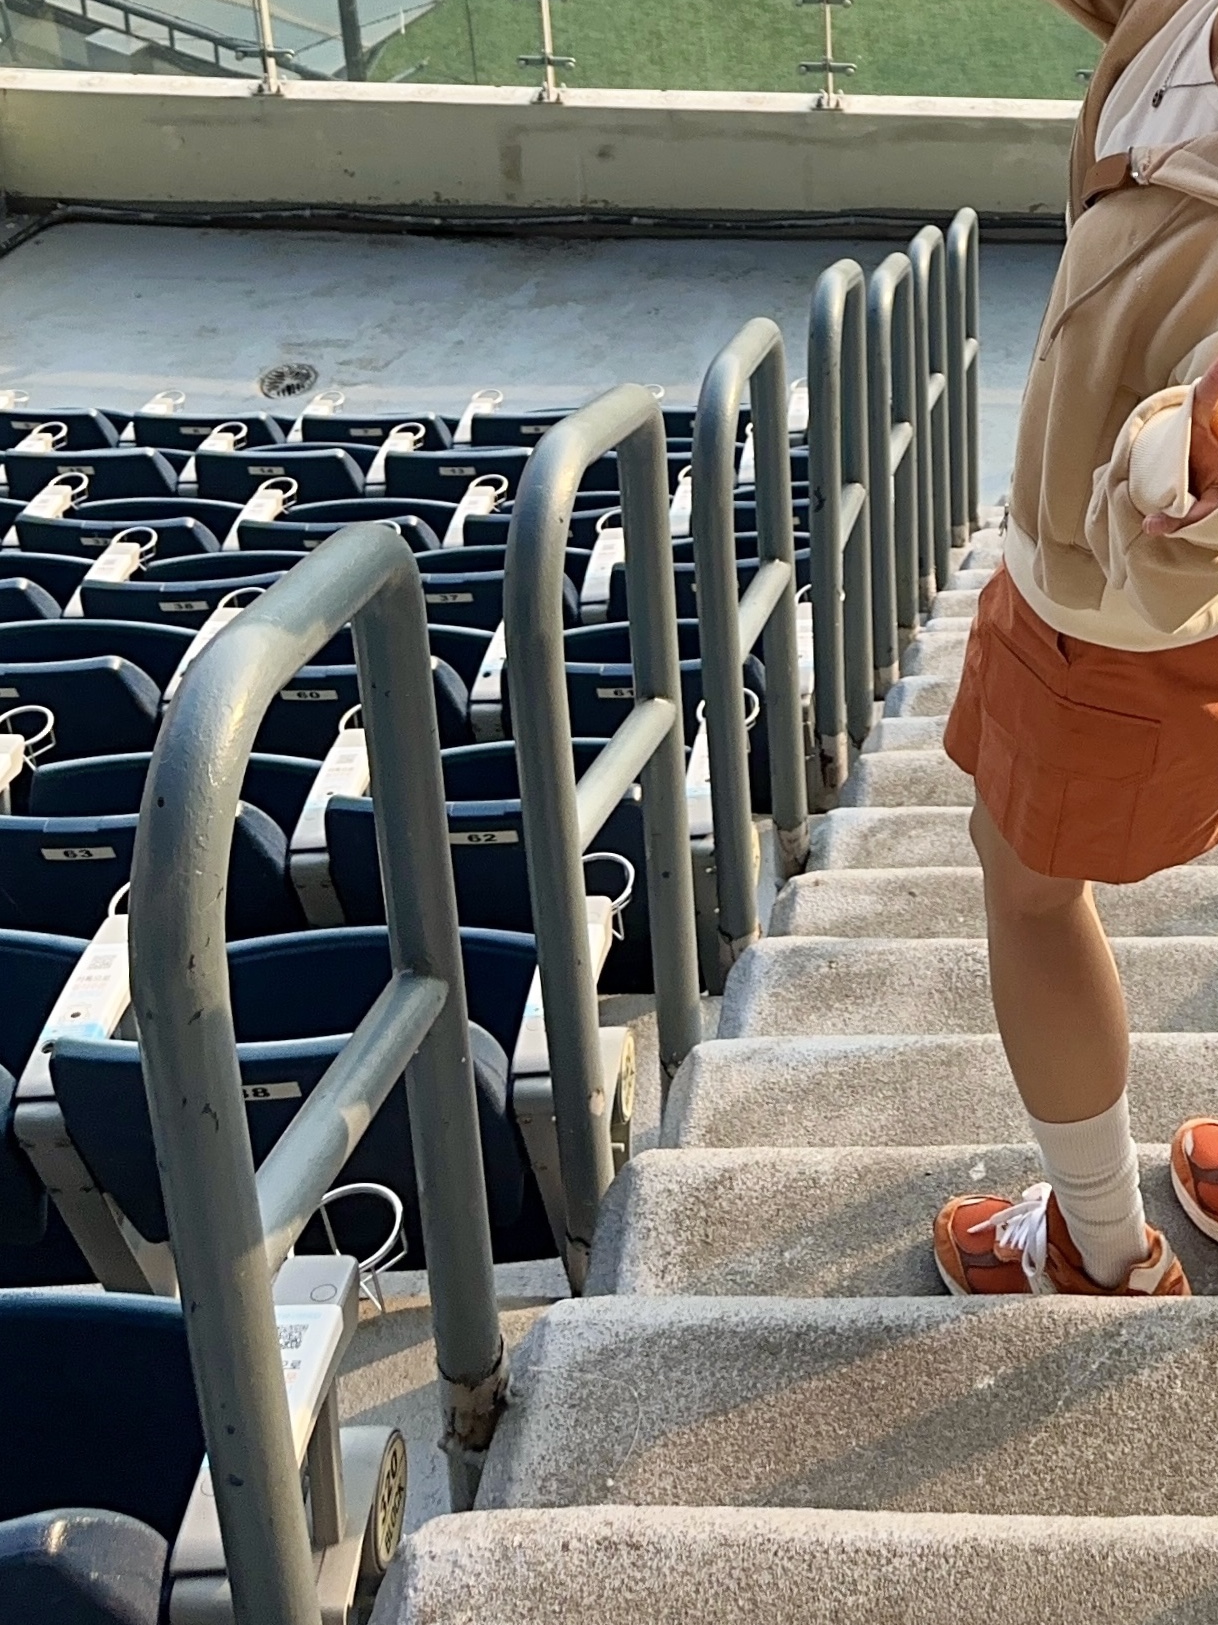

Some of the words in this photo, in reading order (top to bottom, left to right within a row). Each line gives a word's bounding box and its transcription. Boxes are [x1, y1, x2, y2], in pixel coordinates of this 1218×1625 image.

[296, 690, 321, 699] 60
[467, 833, 498, 843] 62
[63, 848, 93, 858] 63
[381, 1449, 397, 1526] 320
